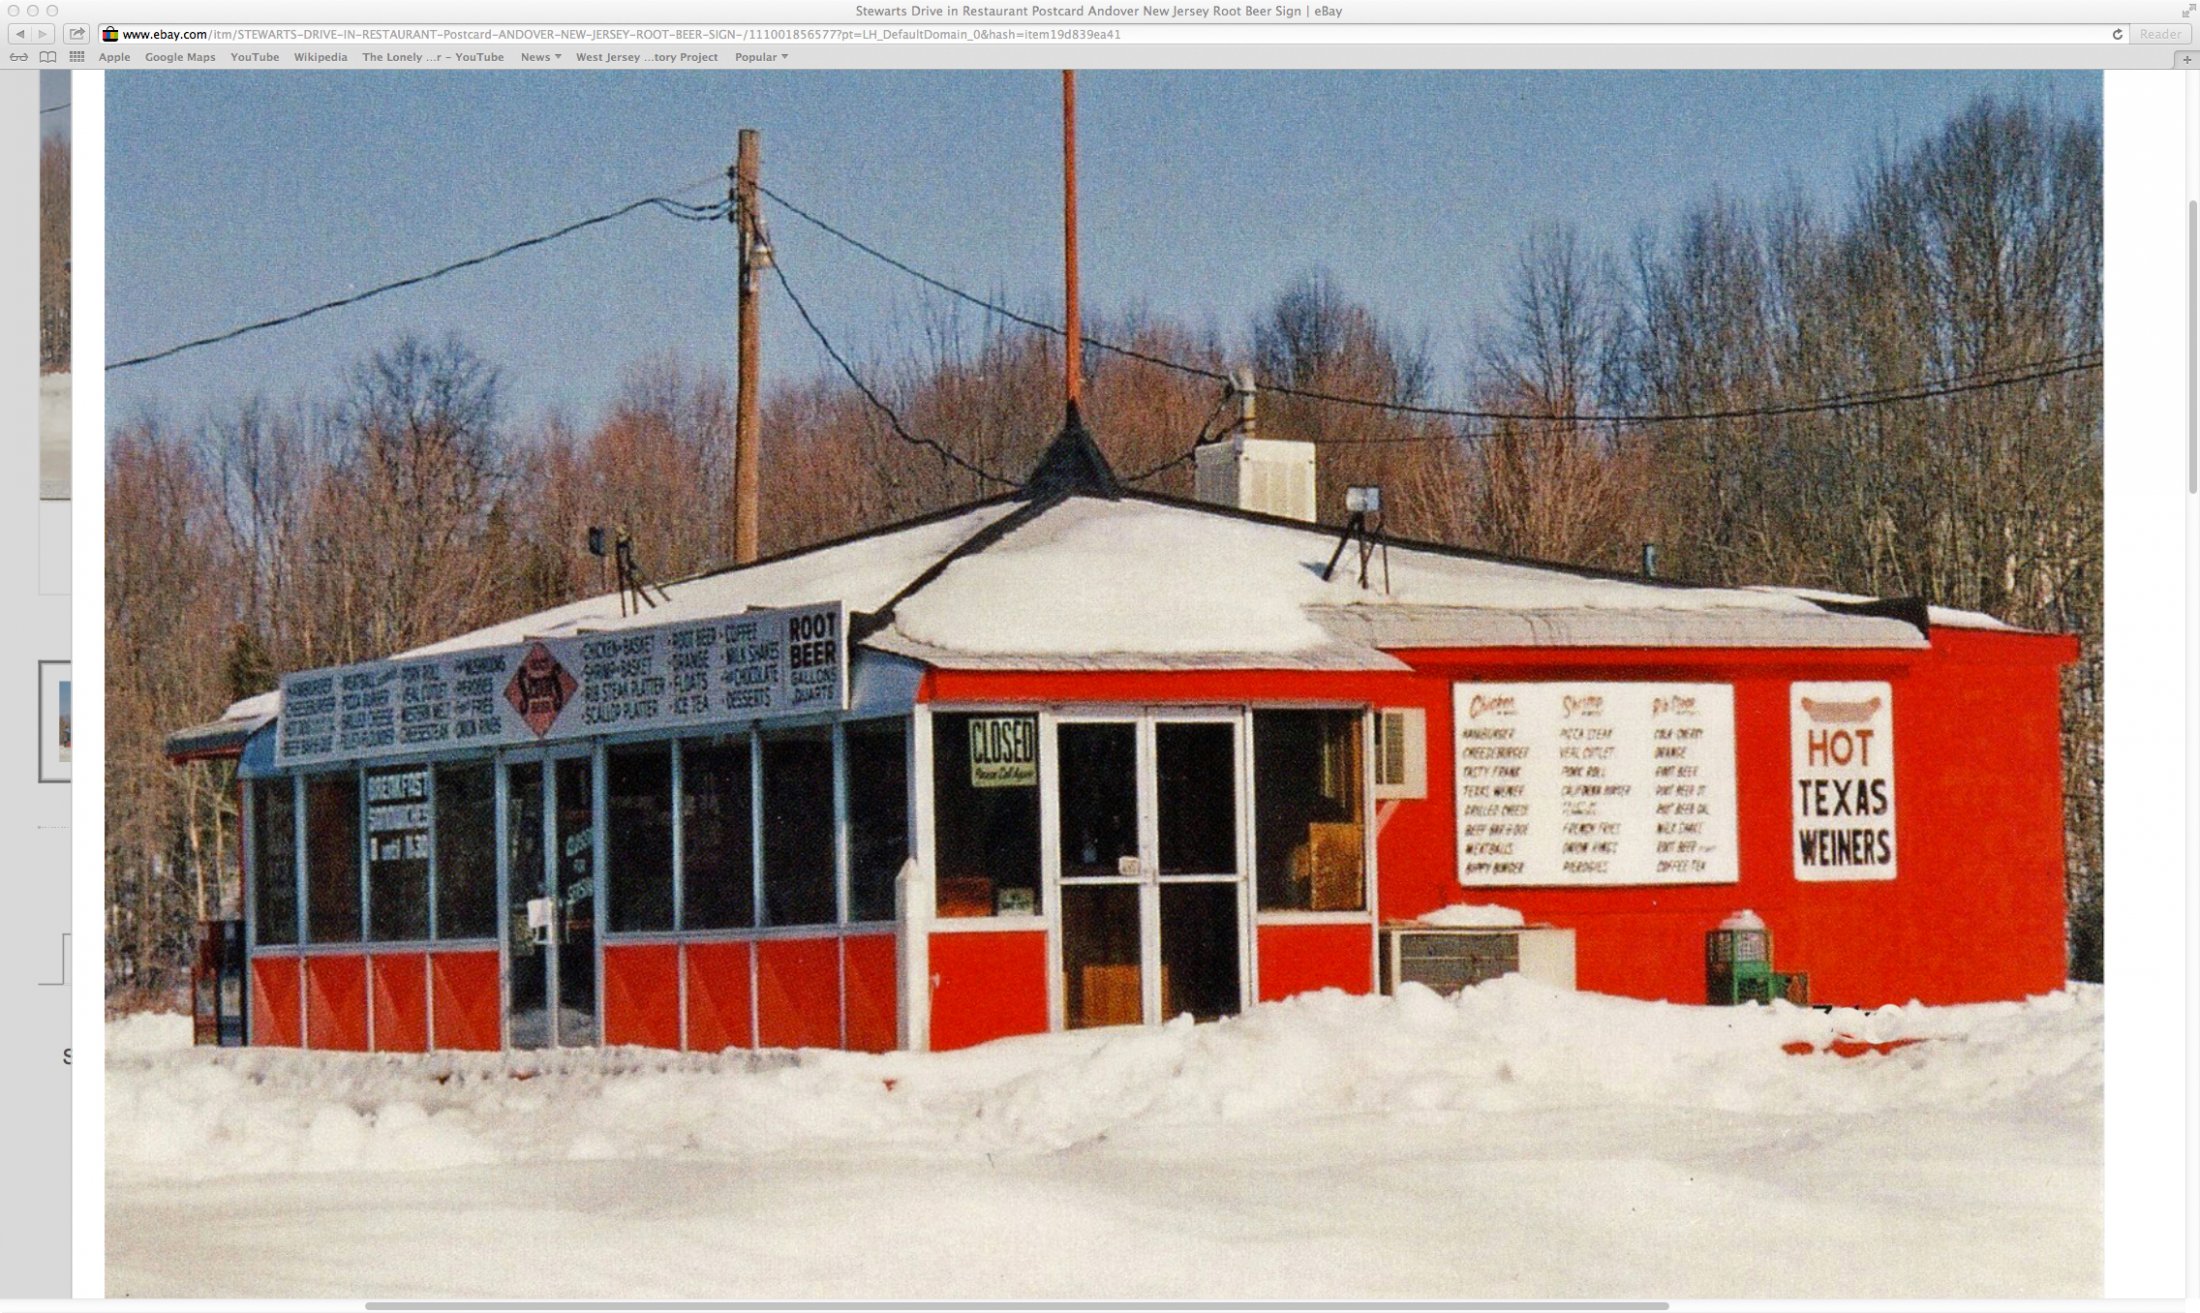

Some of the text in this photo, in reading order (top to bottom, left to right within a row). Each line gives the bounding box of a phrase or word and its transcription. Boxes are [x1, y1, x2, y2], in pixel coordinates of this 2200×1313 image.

[857, 5, 906, 17] Stewarts
[911, 5, 943, 17] Drive
[947, 5, 958, 16] in
[962, 5, 1028, 17] Restaurant
[1032, 5, 1084, 17] Postcard
[1088, 5, 1139, 17] Andover
[1143, 5, 1170, 17] New
[1172, 5, 1209, 19] Jersey
[1213, 5, 1241, 17] Root
[1245, 5, 1272, 17] Beer
[1275, 5, 1302, 19] Sign
[1314, 5, 1343, 19] eBay
[2140, 27, 2183, 41] Reader
[98, 51, 131, 64] Apple
[145, 52, 216, 64] Google Maps
[230, 52, 280, 62] YouTube
[293, 51, 348, 64] Wikipedia
[361, 52, 383, 62] The
[386, 52, 423, 64] Lonely
[455, 52, 504, 62] YouTube
[521, 52, 551, 62] News
[576, 52, 603, 62] West
[604, 52, 641, 64] Jersey
[680, 52, 718, 64] Project
[735, 51, 778, 64] Popular
[789, 612, 836, 642] ROOT
[790, 640, 837, 669] BEER
[791, 666, 838, 686] GALLONS
[972, 719, 1034, 764] CLOSED
[1808, 728, 1876, 768] HOT
[1798, 778, 1889, 817] TEXAS
[1799, 828, 1892, 867] WEINERS
